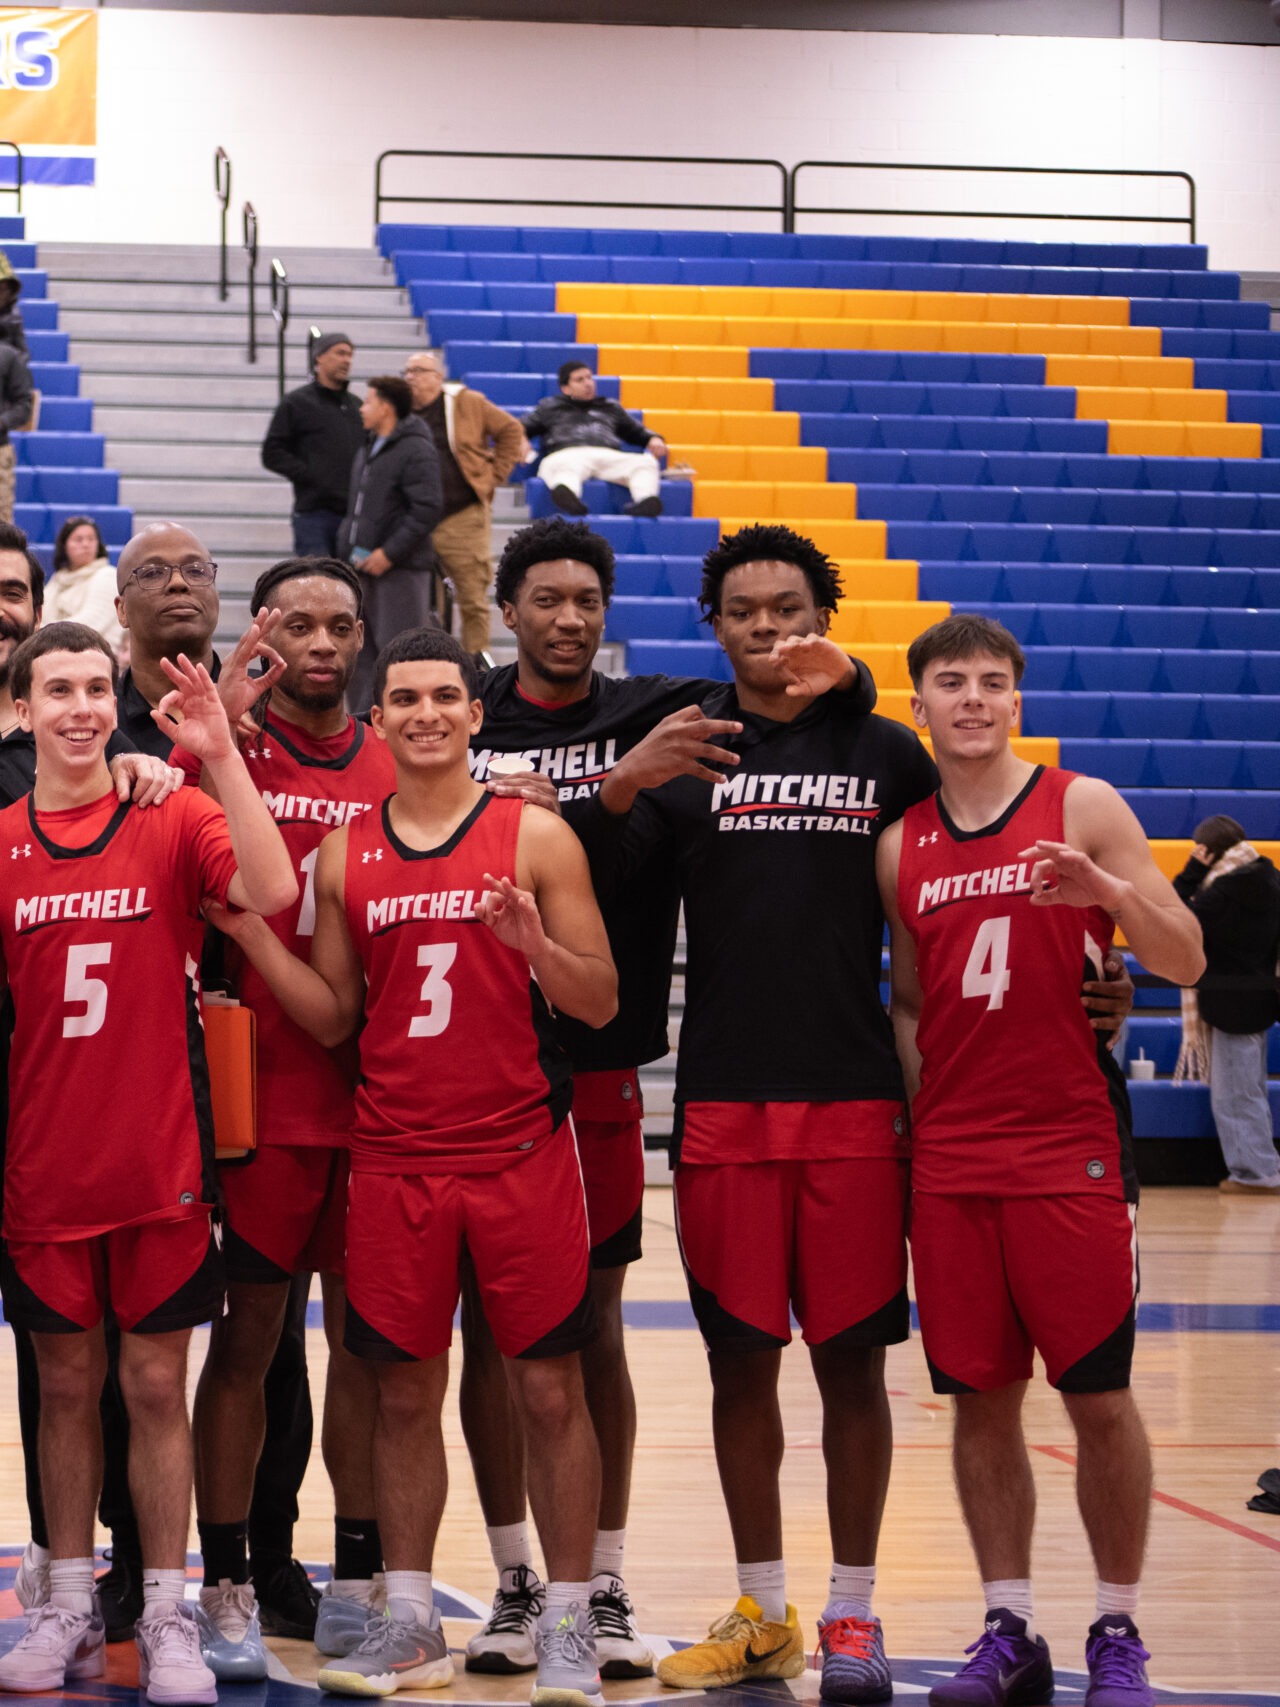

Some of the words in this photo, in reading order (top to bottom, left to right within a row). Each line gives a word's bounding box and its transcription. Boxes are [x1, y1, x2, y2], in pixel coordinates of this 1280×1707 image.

[261, 791, 372, 826] MITCHE
[711, 773, 880, 813] MITCHELL
[719, 815, 871, 835] BASKETBALL
[15, 887, 152, 932] MITCHELL
[918, 862, 1031, 914] MITCHEL
[962, 915, 1011, 1011] 4
[62, 942, 112, 1038] 5
[408, 942, 458, 1037] 3
